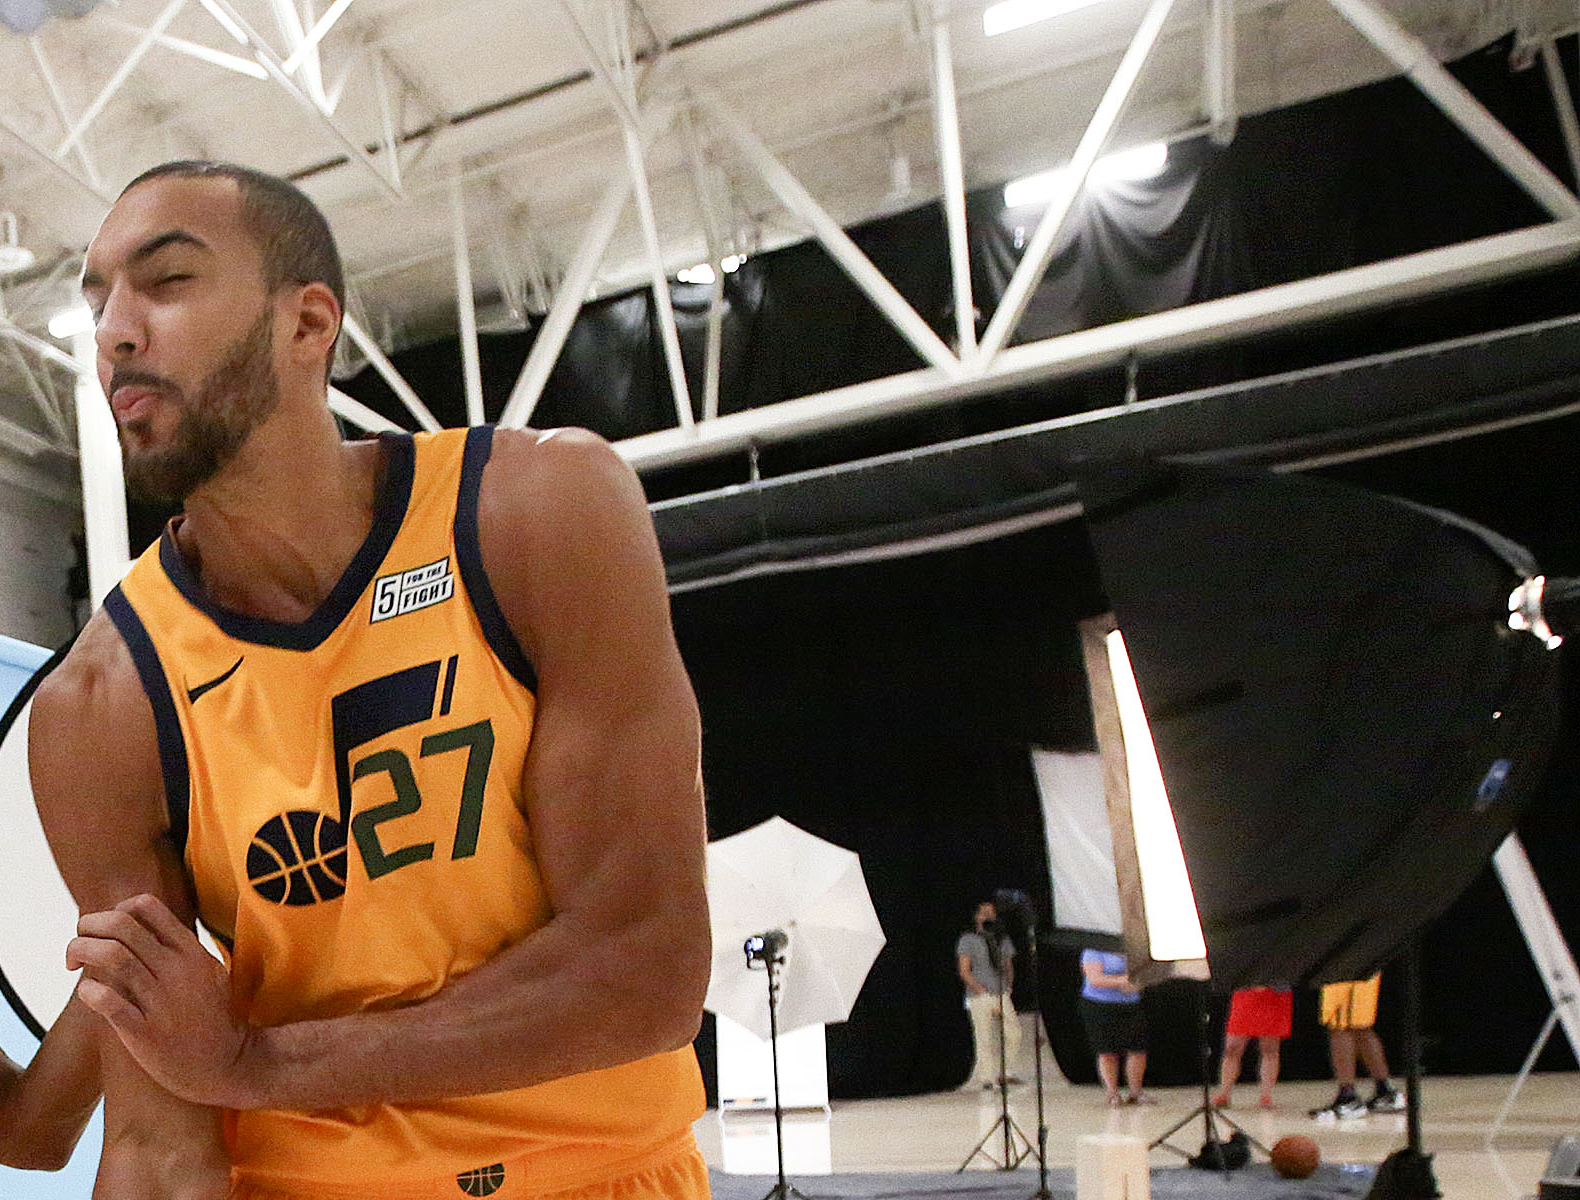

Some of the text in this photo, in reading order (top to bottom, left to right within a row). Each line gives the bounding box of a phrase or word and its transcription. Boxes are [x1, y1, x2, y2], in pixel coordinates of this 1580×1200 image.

[407, 566, 441, 584] FOR THE
[378, 580, 396, 614] 5
[403, 580, 448, 609] FIGHT
[351, 719, 495, 880] 27
